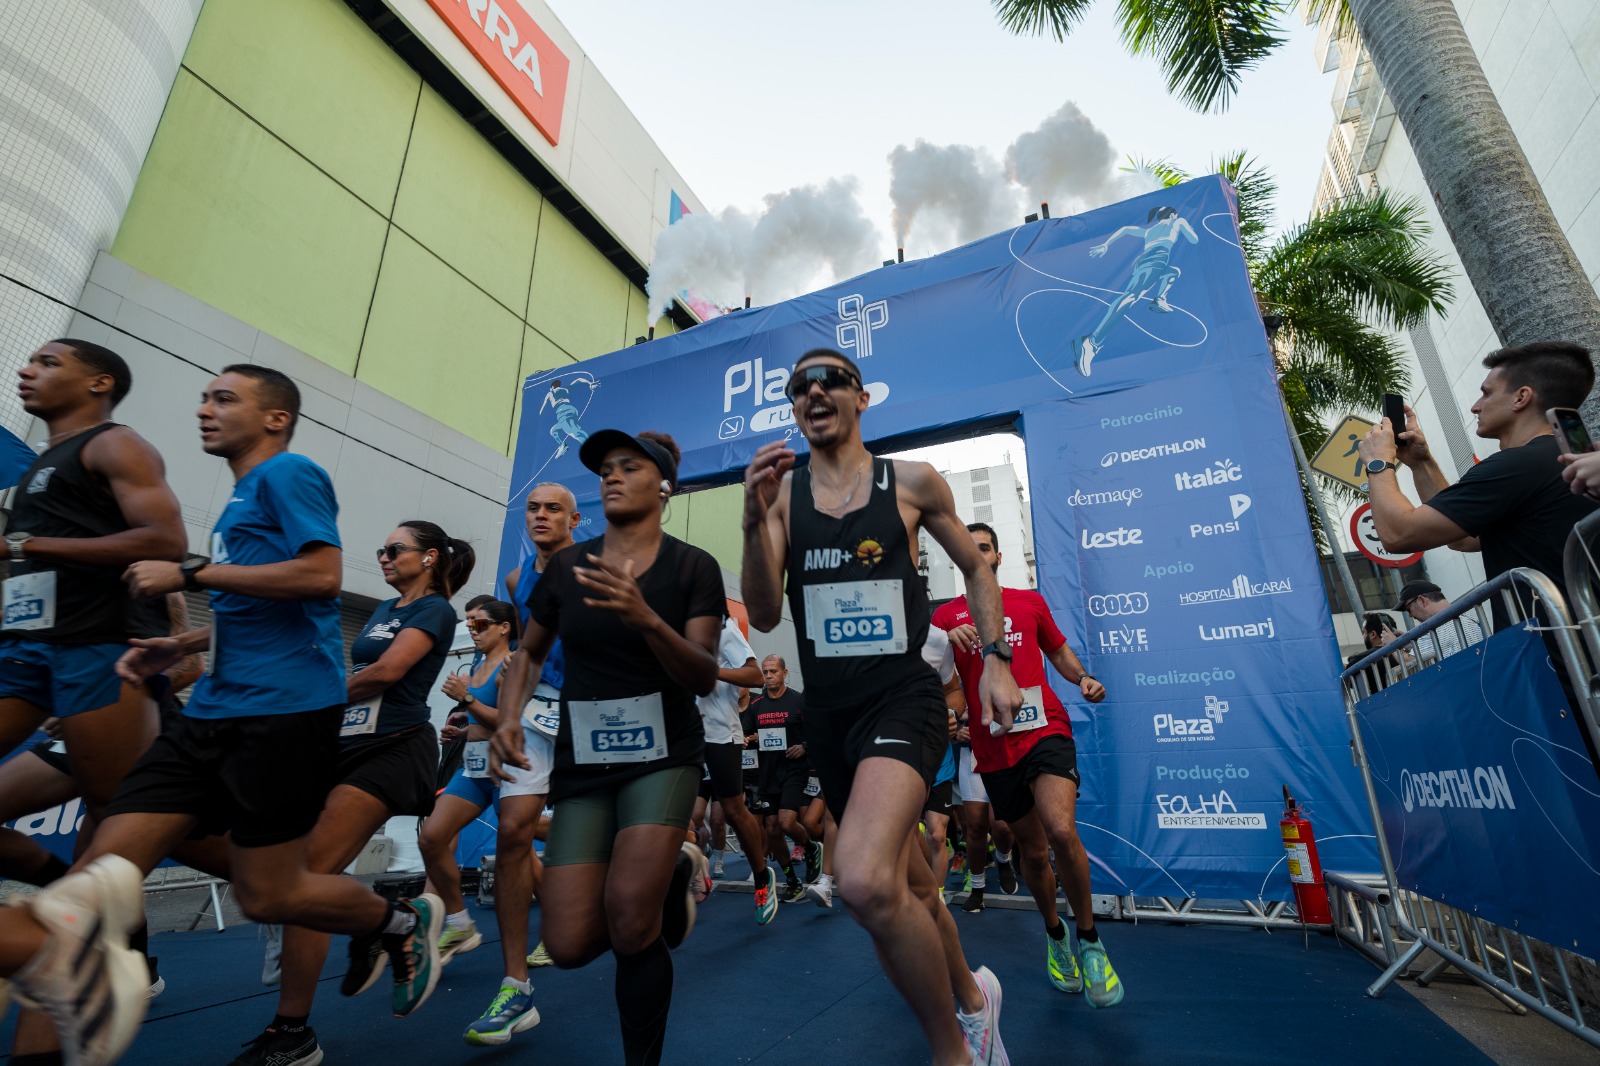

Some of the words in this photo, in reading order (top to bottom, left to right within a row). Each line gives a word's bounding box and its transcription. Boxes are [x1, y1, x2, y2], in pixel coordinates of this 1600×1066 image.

[723, 357, 796, 413] Pla
[1100, 405, 1183, 429] Patrocínio
[1121, 437, 1206, 463] DECATHLON
[1067, 487, 1143, 507] dermage
[1190, 520, 1240, 538] Pensi
[804, 548, 853, 571] AMD+
[1143, 560, 1195, 579] Apoio
[1088, 591, 1149, 616] BOLD
[1179, 587, 1235, 604] HOSPITAL
[830, 618, 888, 641] 5002
[1099, 626, 1148, 648] LEVE
[1199, 617, 1274, 641] Lumarj
[1101, 644, 1149, 655] EYEWEAR
[1134, 667, 1236, 686] Realização
[1153, 713, 1214, 736] Plaza
[597, 730, 649, 750] 5124
[1155, 764, 1250, 783] Produção
[1412, 766, 1516, 810] DECATHLON
[1156, 790, 1237, 814] FOLHA
[1163, 816, 1260, 826] ENTRETENIMENTO
